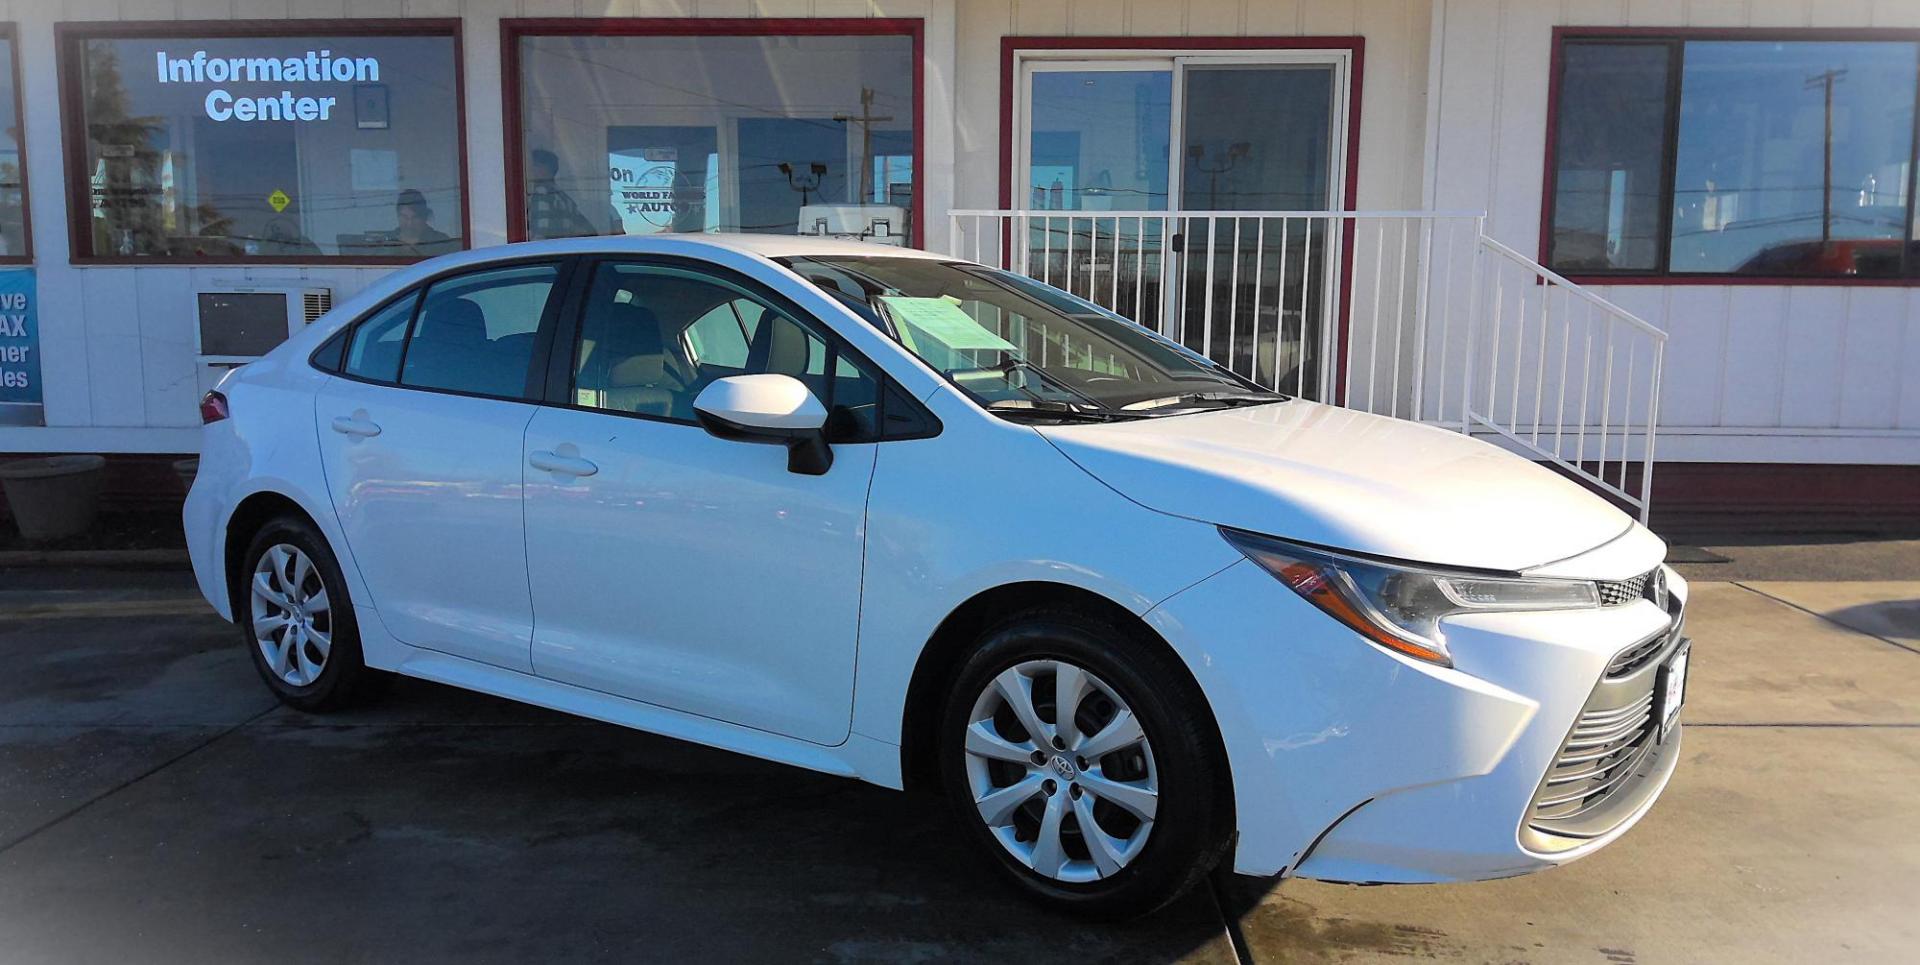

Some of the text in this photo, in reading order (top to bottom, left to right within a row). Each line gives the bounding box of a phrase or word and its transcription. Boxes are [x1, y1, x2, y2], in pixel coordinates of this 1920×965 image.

[157, 50, 379, 82] Information
[205, 89, 335, 121] Center
[621, 191, 660, 199] WORLD
